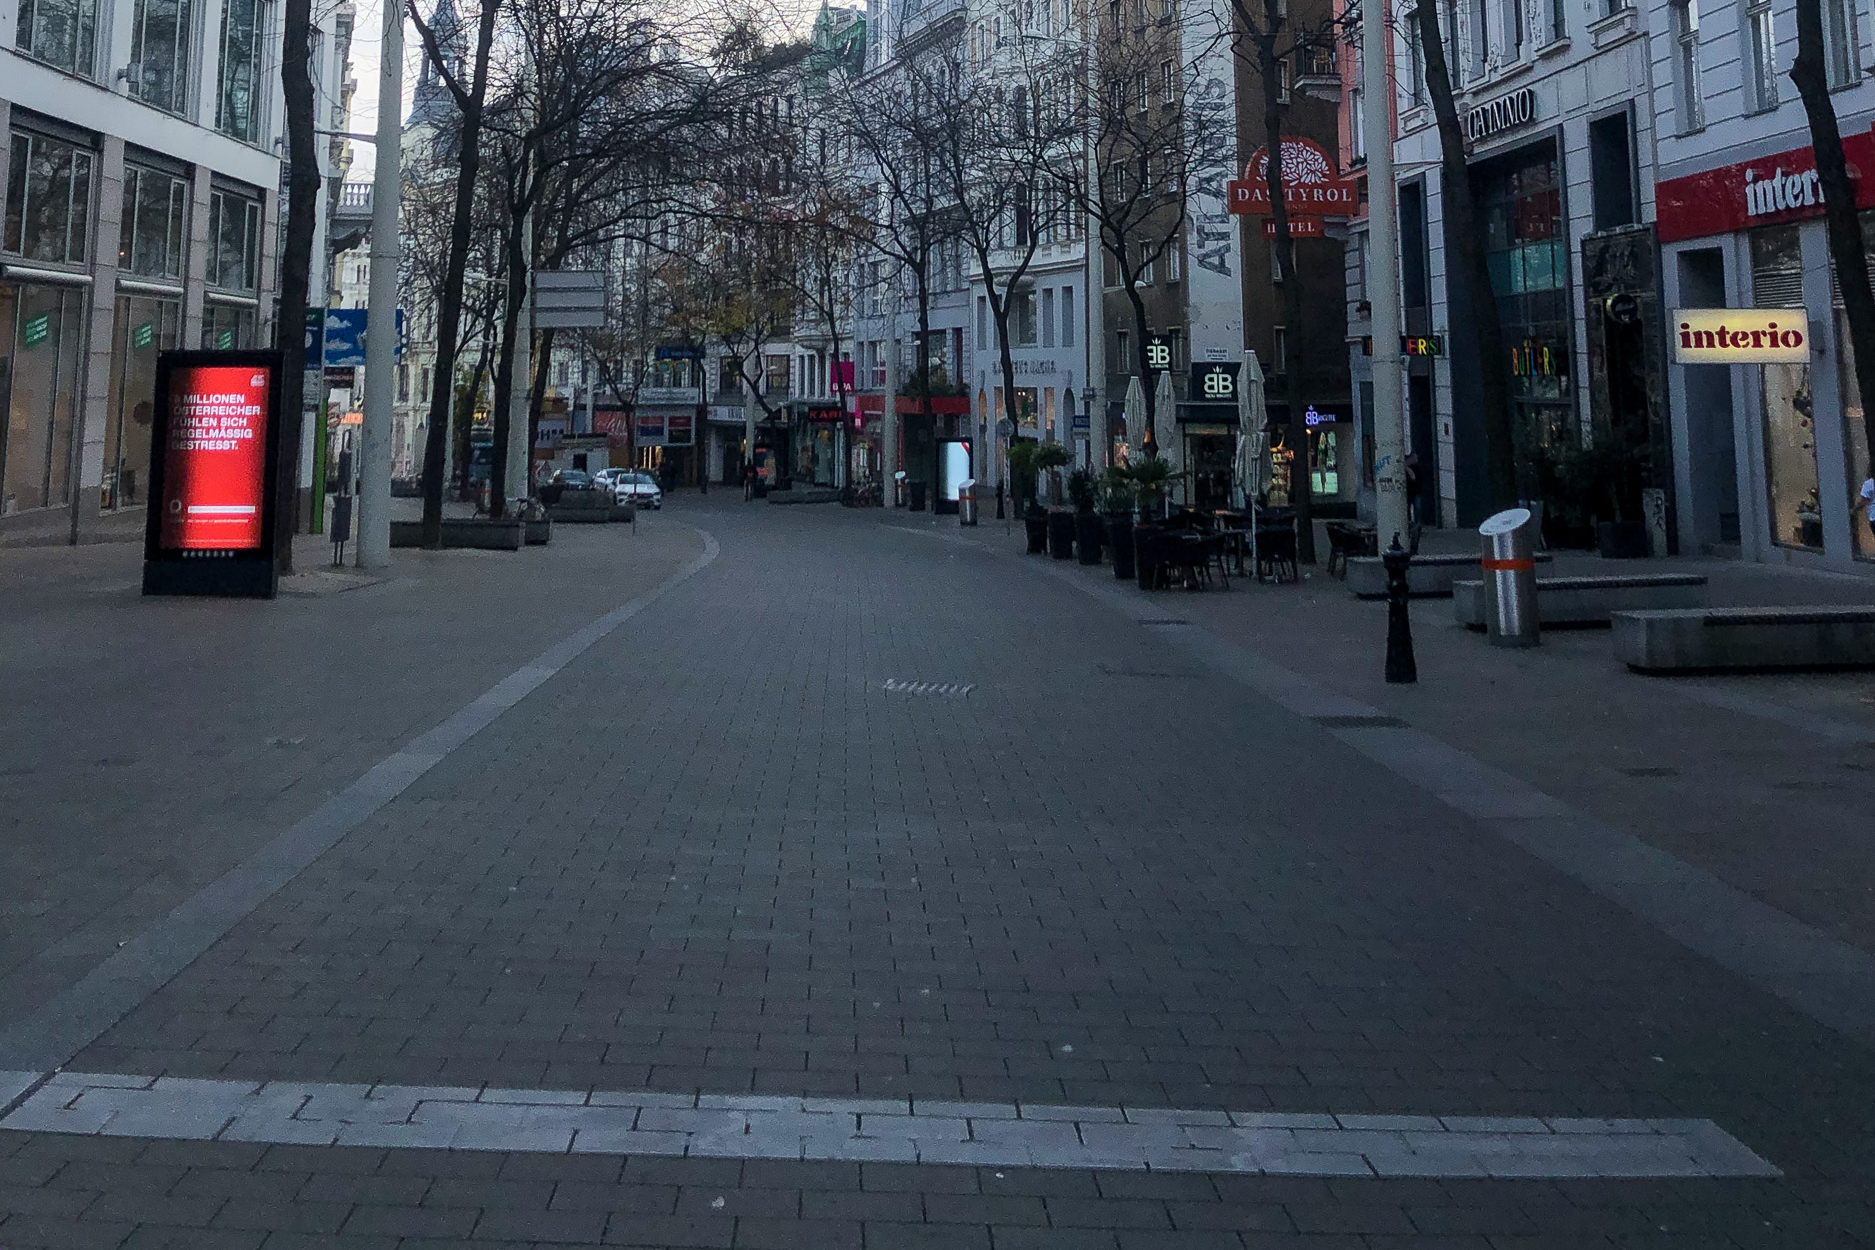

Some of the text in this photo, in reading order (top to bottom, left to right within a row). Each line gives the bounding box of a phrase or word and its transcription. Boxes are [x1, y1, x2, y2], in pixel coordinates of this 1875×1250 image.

[1488, 88, 1531, 134] IMMO
[1284, 188, 1352, 202] TYROL
[1267, 222, 1315, 233] HTEL
[1679, 322, 1803, 349] interio
[183, 393, 245, 404] MILLIONEN
[220, 417, 247, 427] SICH
[171, 426, 253, 439] REGELMÄSSIG
